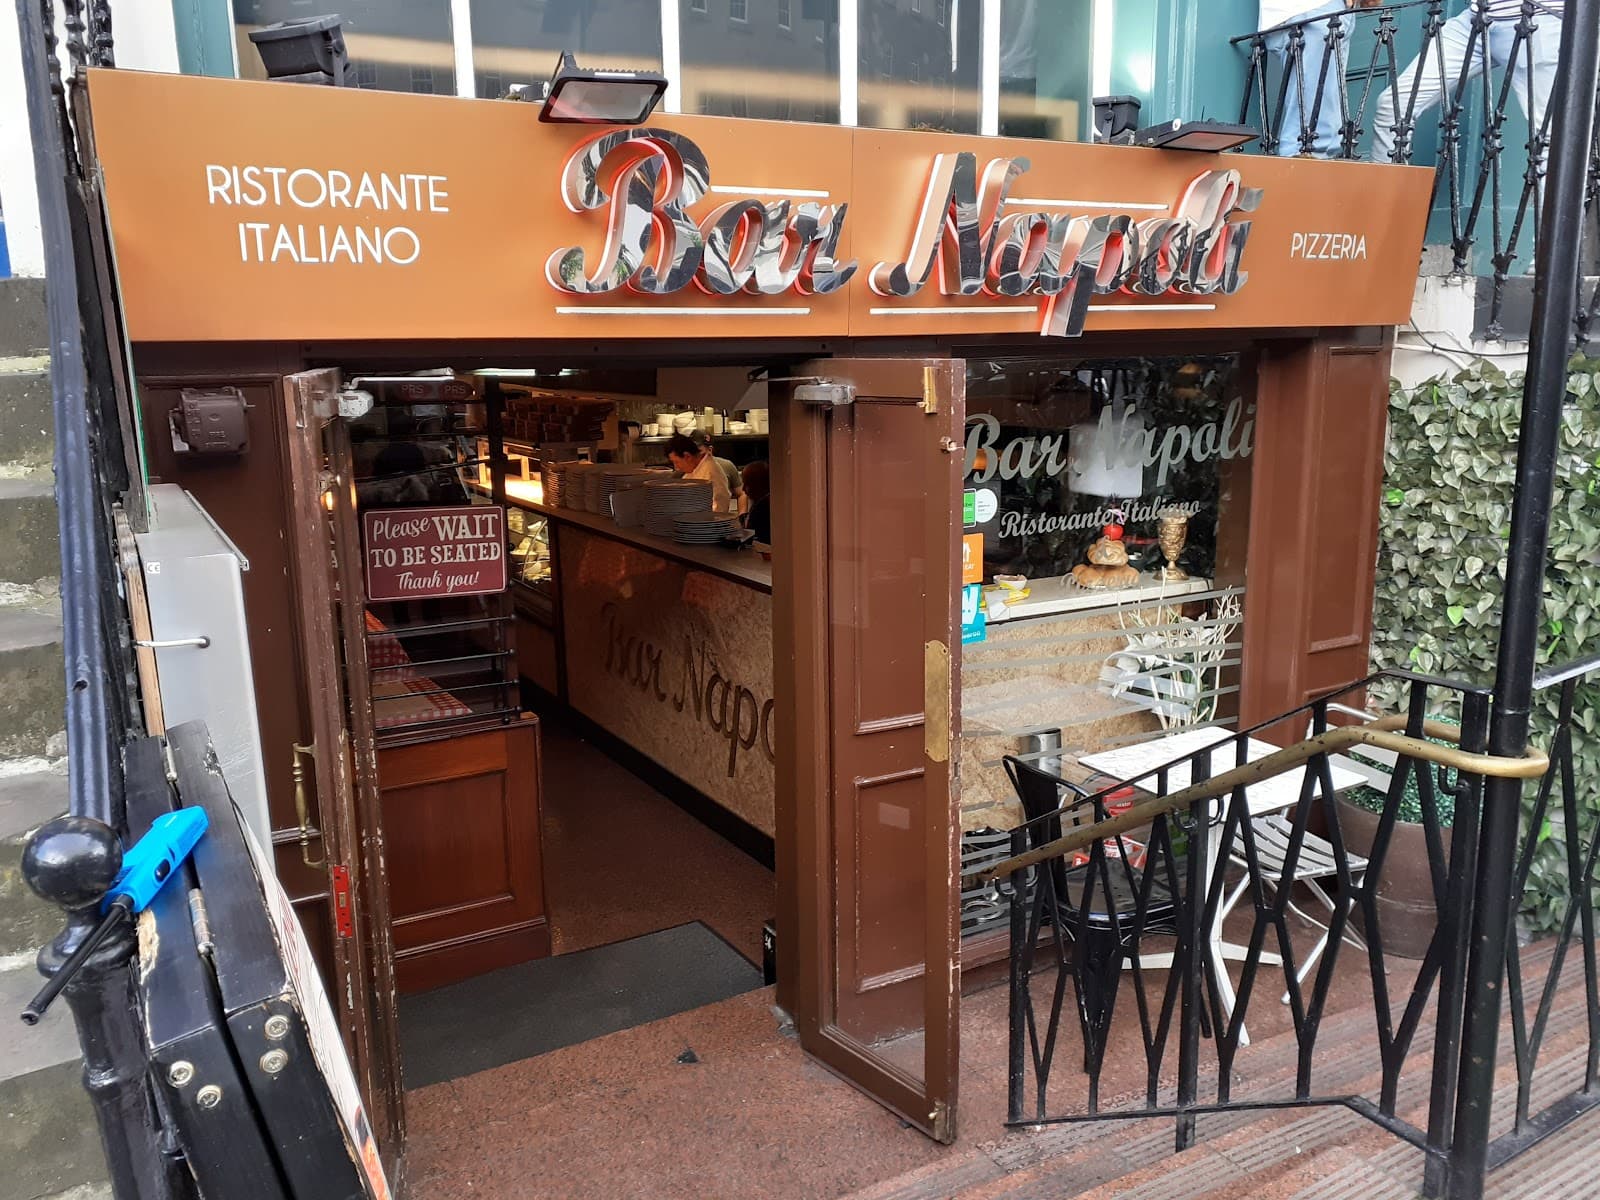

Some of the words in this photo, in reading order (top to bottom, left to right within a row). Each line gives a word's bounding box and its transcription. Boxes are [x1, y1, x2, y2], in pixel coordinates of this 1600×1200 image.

[205, 164, 449, 212] RISTORANTE
[238, 222, 420, 264] ITALIANO
[545, 127, 860, 296] Bar
[867, 152, 1264, 337] Napoli
[1290, 232, 1366, 260] PIZZERIA
[963, 413, 1067, 483] Bar
[1072, 396, 1256, 487] Napoli
[373, 516, 432, 542] Please
[431, 513, 499, 541] WAIT
[998, 505, 1112, 539] Ristorante
[1117, 495, 1201, 525] Italiano
[370, 548, 397, 568] TO
[401, 545, 427, 567] BE
[430, 542, 501, 564] SEATED
[394, 569, 443, 590] Thank
[445, 571, 480, 592] you!
